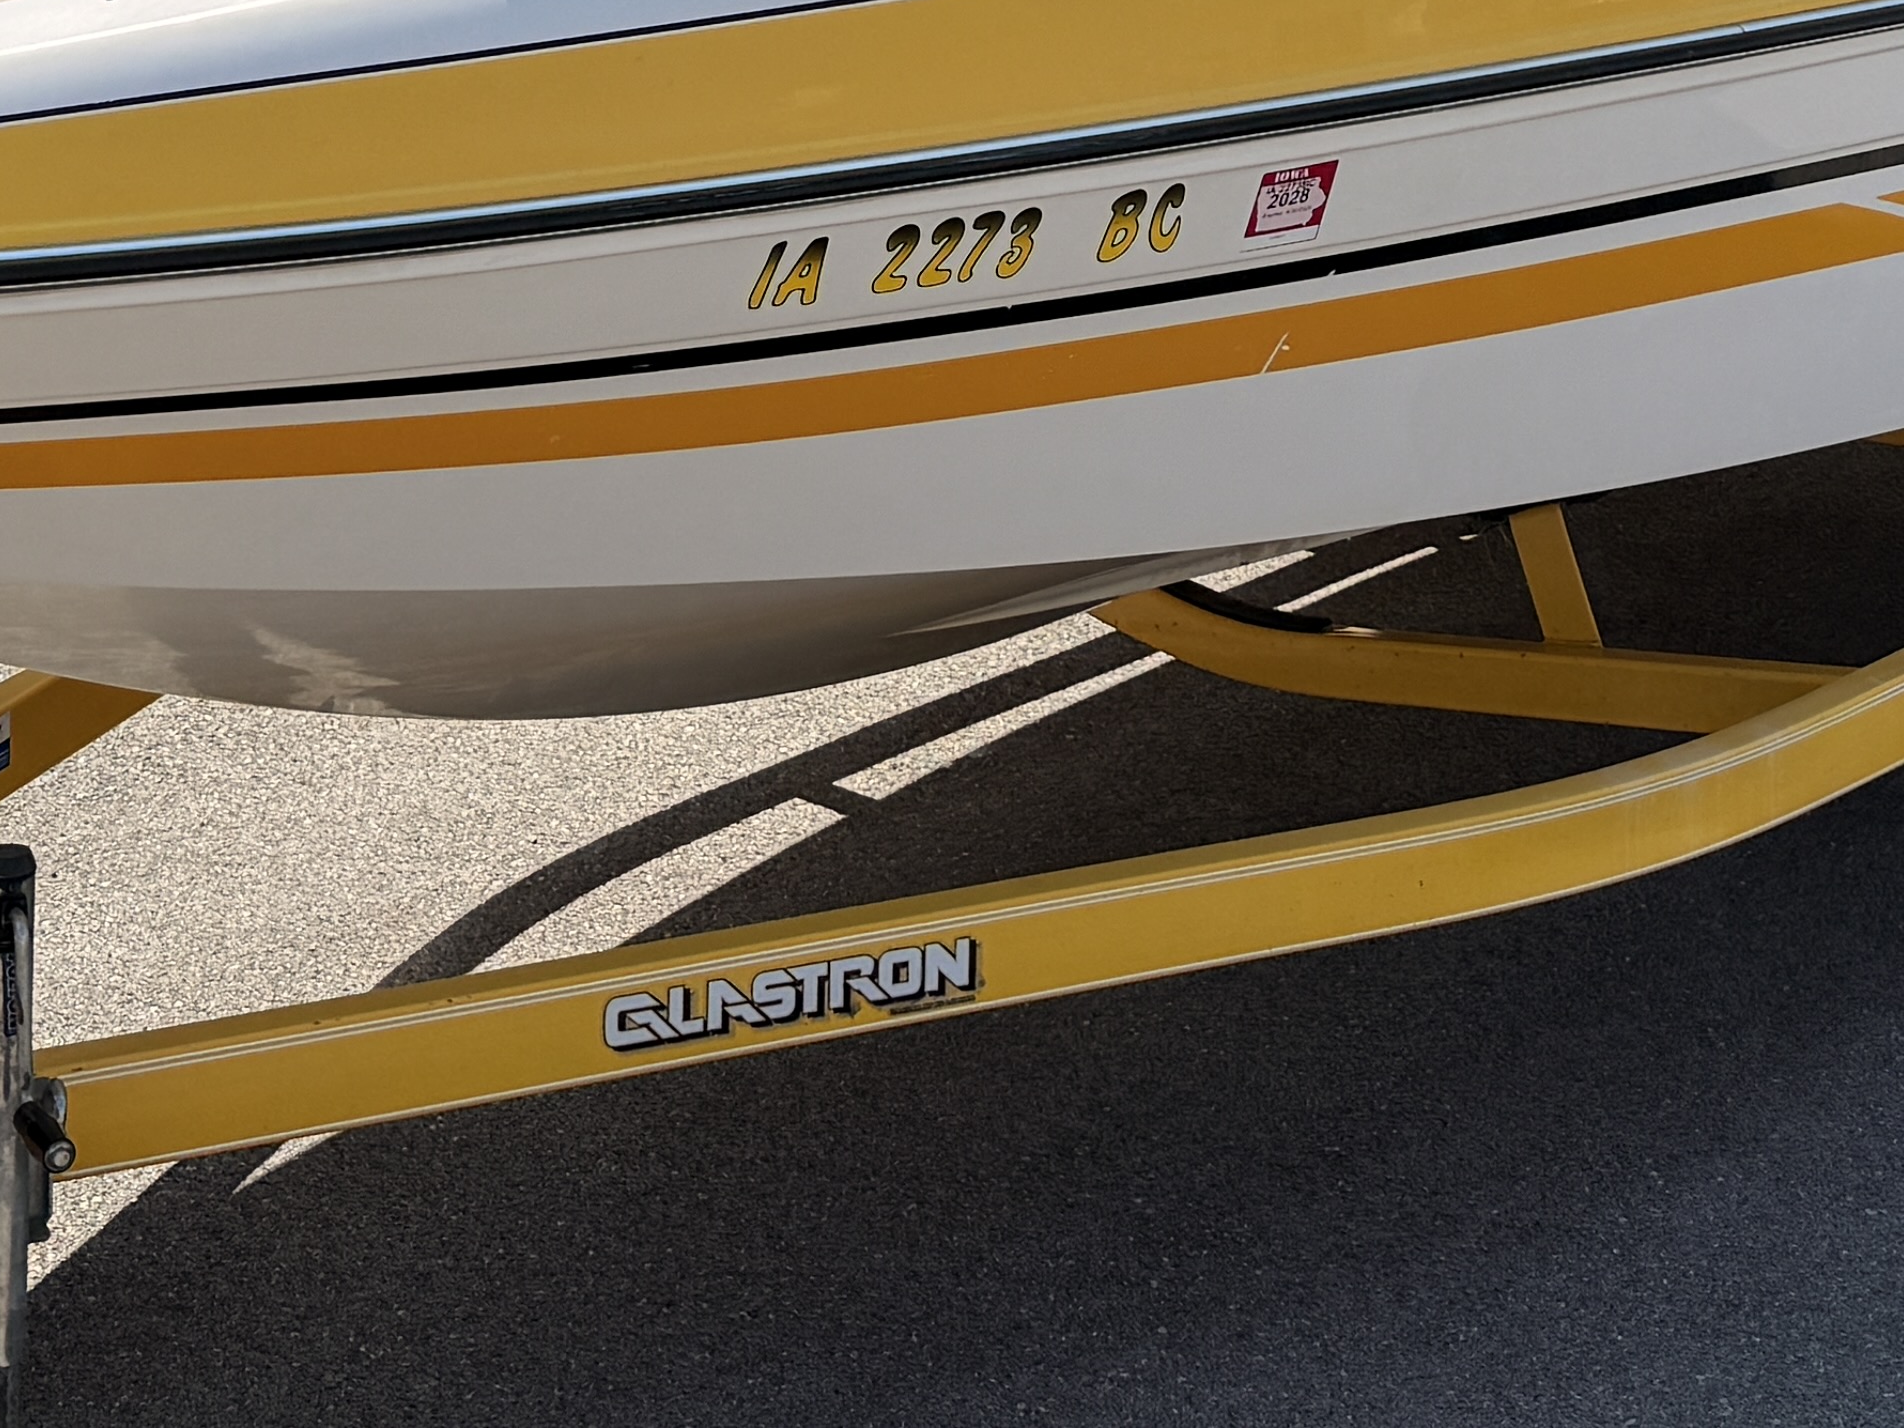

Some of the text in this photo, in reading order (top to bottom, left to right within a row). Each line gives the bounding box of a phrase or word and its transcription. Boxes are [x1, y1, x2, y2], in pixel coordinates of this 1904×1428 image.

[1266, 187, 1311, 210] 2028
[1274, 167, 1309, 183] IOWA
[748, 182, 1187, 310] IA 2273 BC
[603, 936, 979, 1053] GLASTRON
